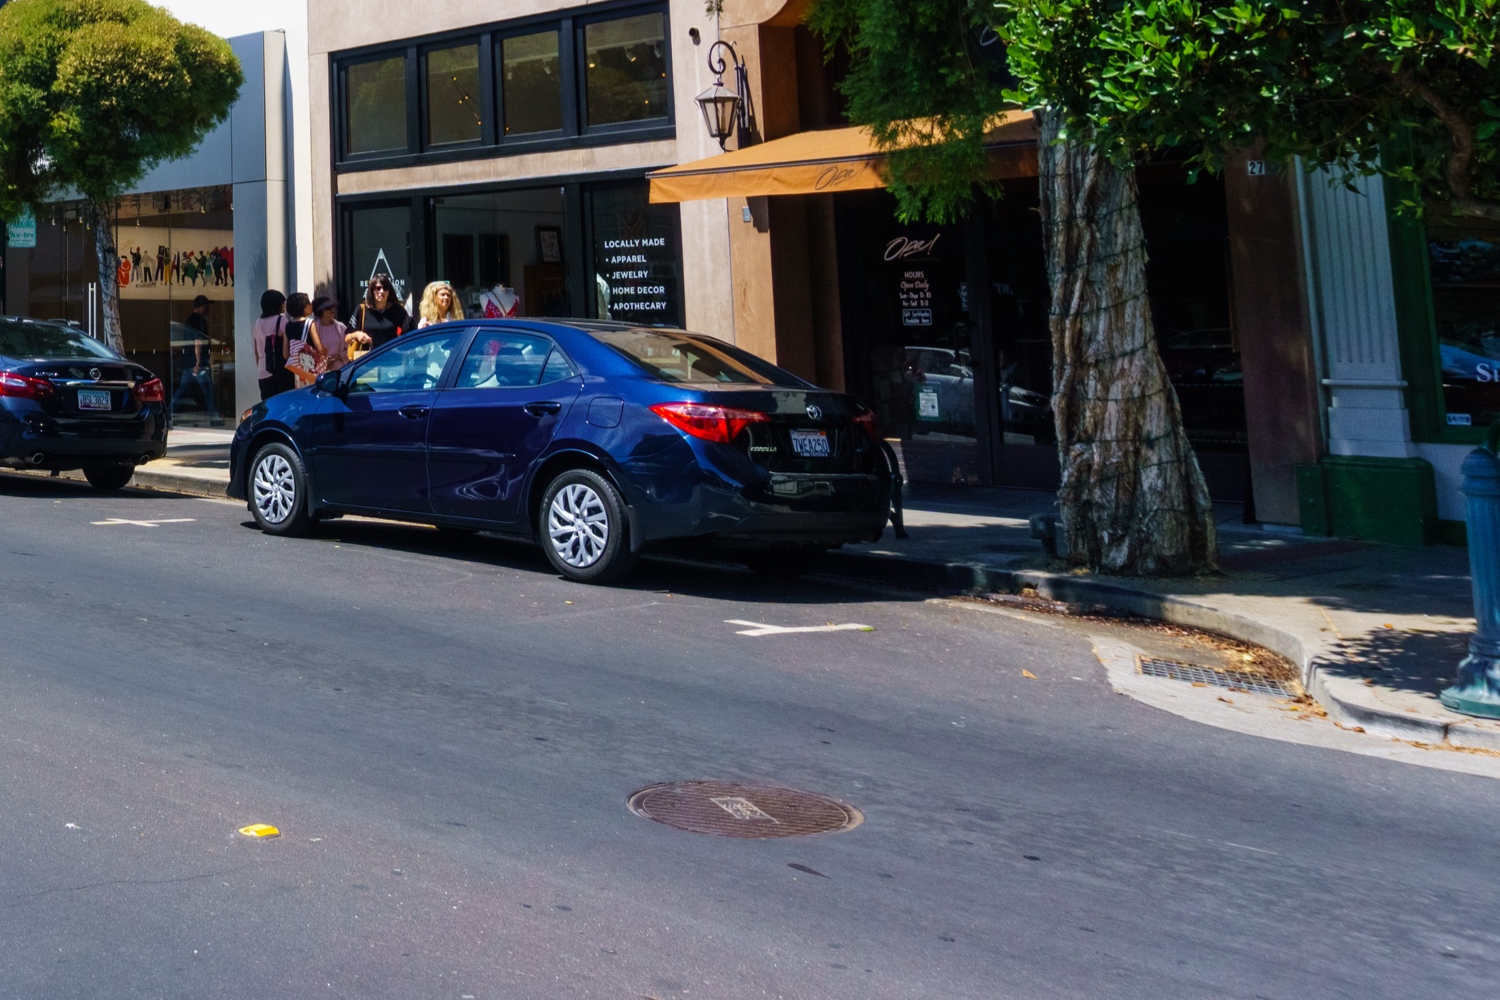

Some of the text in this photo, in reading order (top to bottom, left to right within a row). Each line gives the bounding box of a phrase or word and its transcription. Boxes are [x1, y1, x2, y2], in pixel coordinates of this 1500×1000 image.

[1249, 161, 1263, 175] 27
[604, 238, 665, 249] LOCALLY MADE
[611, 255, 647, 263] APPAREL
[612, 270, 649, 279] JEWELRY
[612, 285, 665, 294] HOME DECOR
[613, 301, 667, 311] APOTHECARY
[792, 438, 829, 453] 7WEA250
